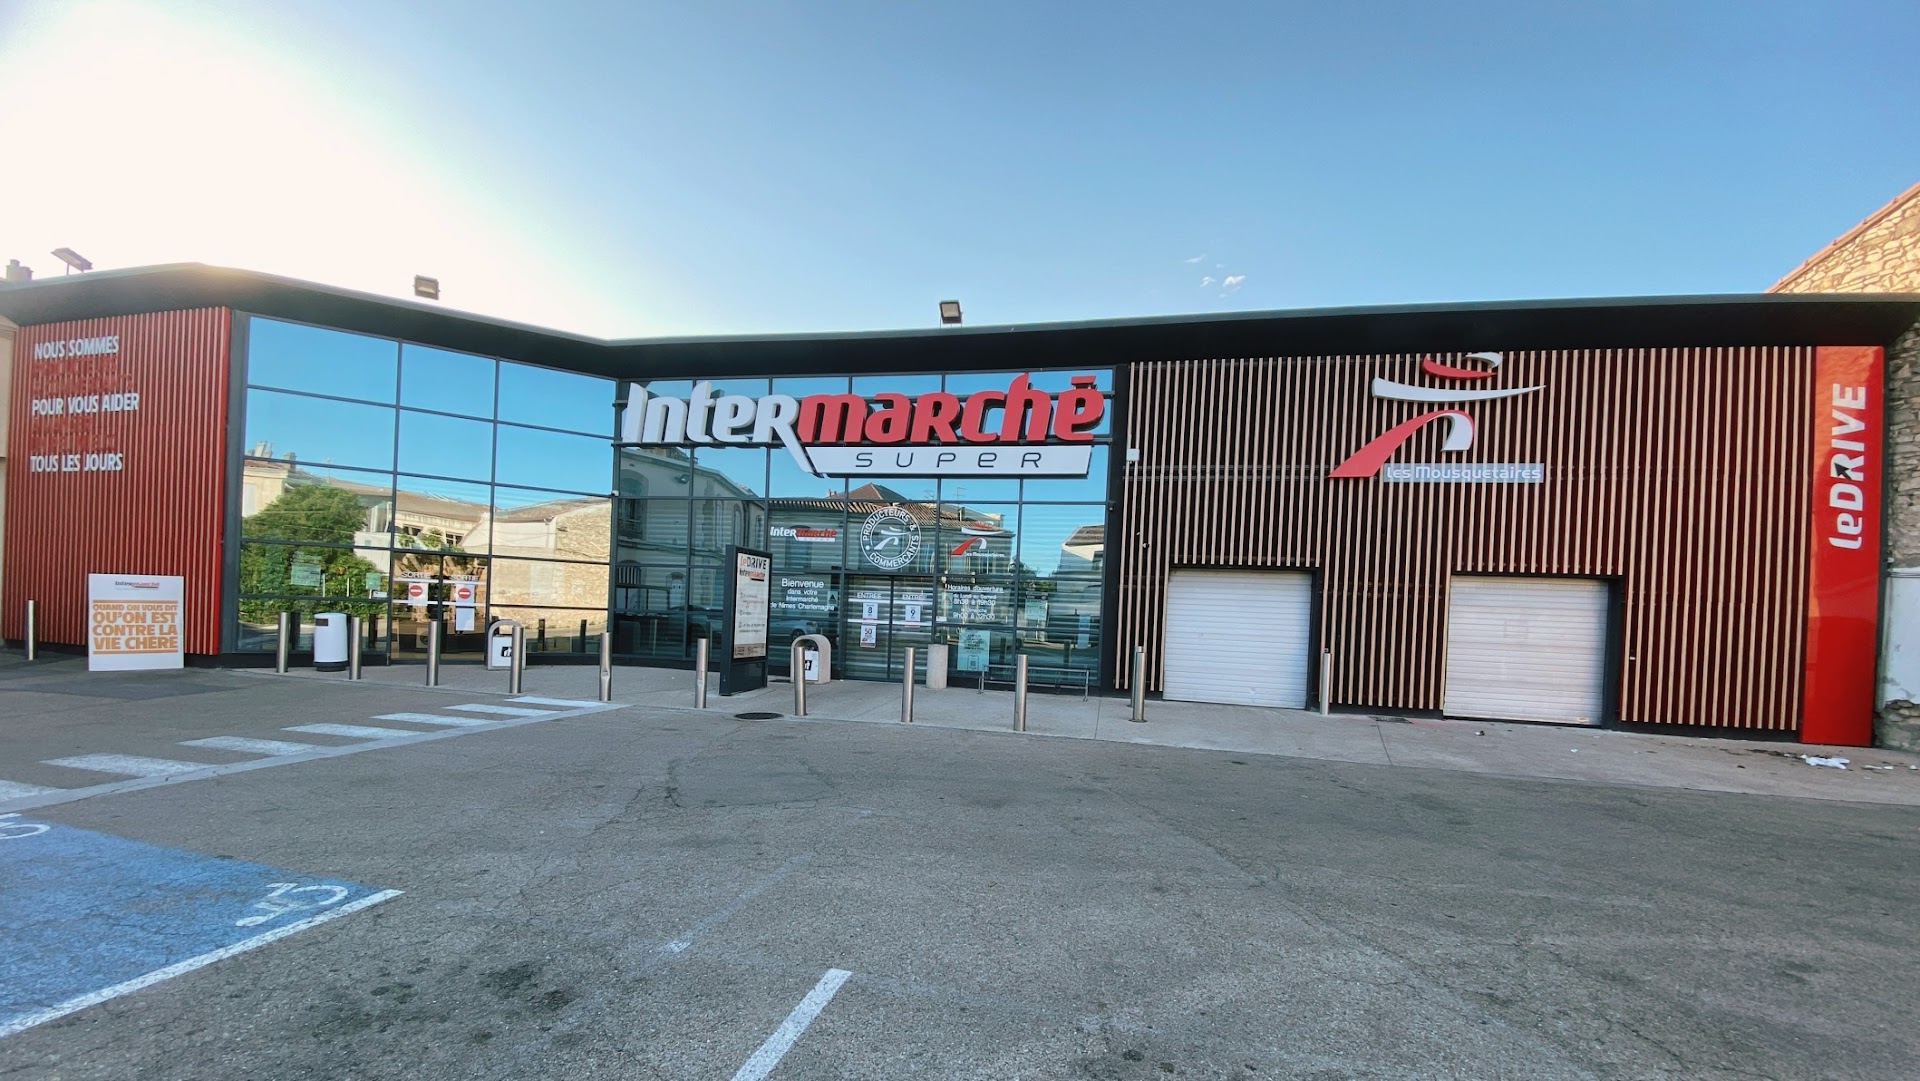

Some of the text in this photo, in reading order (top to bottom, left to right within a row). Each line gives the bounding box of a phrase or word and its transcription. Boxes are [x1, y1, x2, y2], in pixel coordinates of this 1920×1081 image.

[34, 336, 119, 359] NOUS SOMMES
[32, 393, 139, 416] POUR VOUS AIDER
[30, 453, 123, 473] TOUS LES JOURS
[855, 452, 1042, 468] SUPER
[1415, 466, 1541, 482] Mousquetaires
[862, 508, 911, 541] PRODUCTEURS
[781, 578, 825, 589] Bienvenue
[92, 611, 178, 624] QU'ON EST
[92, 624, 178, 636] CONTRE LA
[93, 636, 121, 649] VIE
